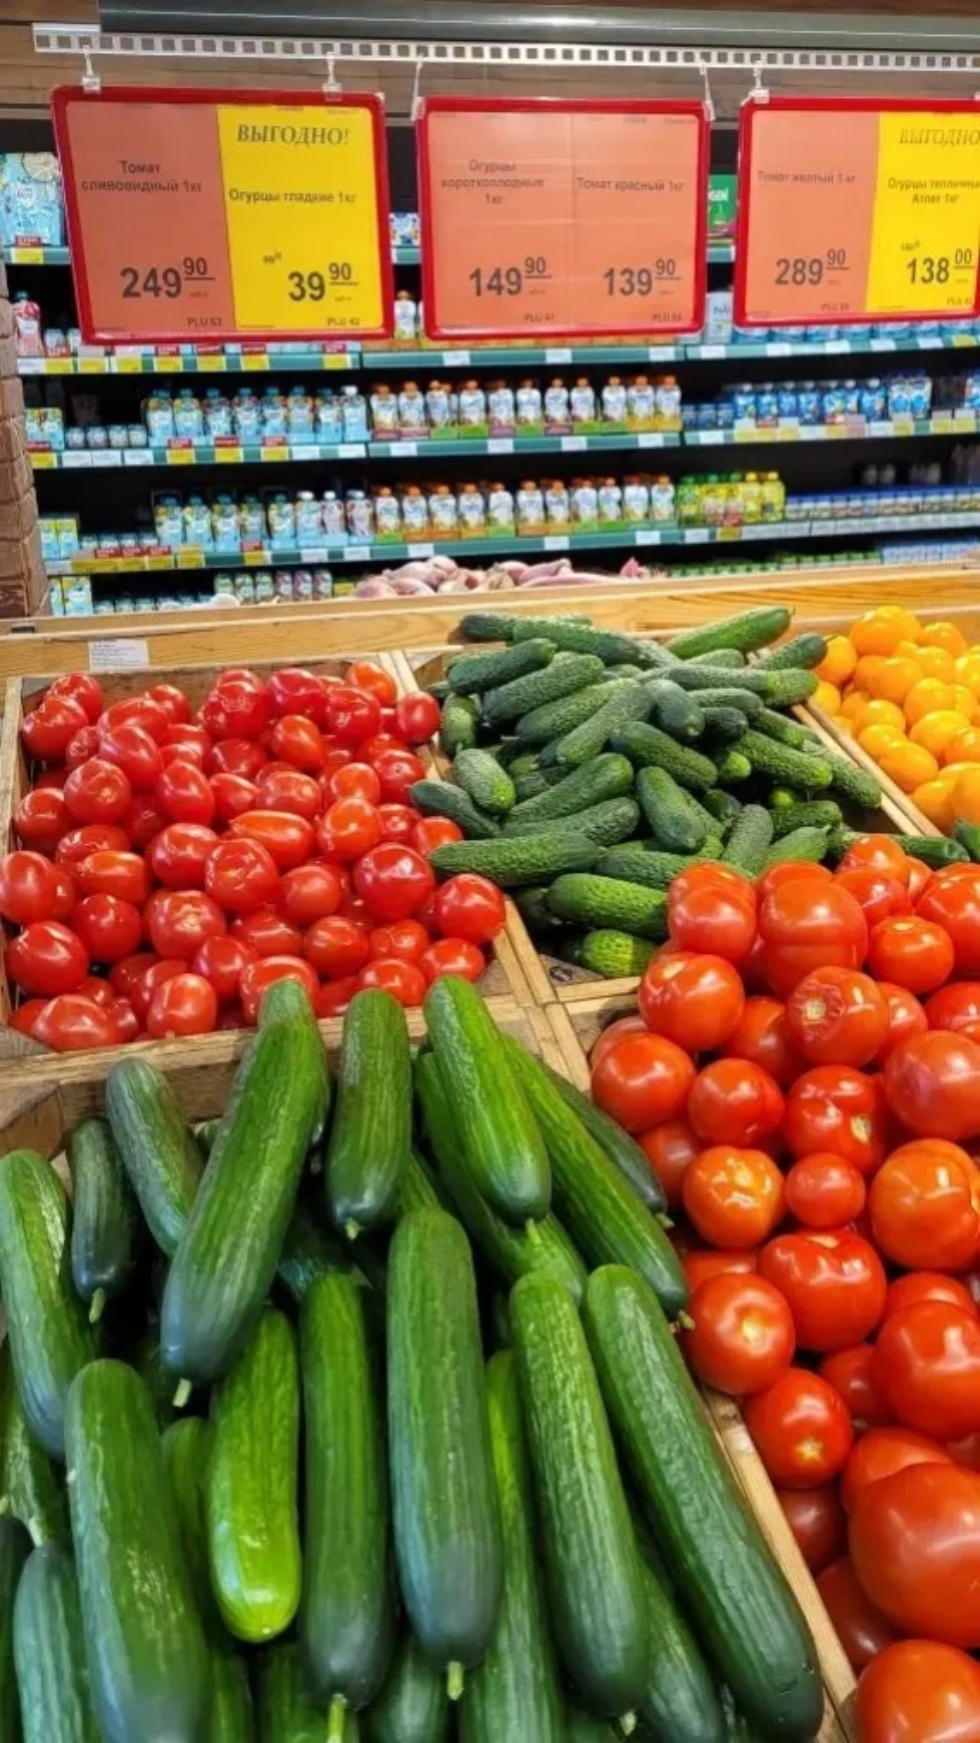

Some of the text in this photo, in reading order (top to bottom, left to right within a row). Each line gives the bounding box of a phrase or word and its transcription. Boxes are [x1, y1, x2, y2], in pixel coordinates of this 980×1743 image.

[236, 124, 350, 146] ВЫГОДНО!
[119, 160, 161, 174] Томат
[469, 159, 516, 173] Огурцы
[81, 180, 203, 194] сливовидный 1кг
[577, 177, 612, 190] Томат
[614, 180, 665, 193] красный
[888, 177, 928, 191] Огурцы
[229, 188, 280, 204] Огурцы
[284, 191, 334, 204] гладкие
[774, 249, 847, 285] 289 90
[907, 248, 972, 284] 138 00
[120, 257, 208, 298] 249 90
[288, 262, 352, 301] 39 90
[469, 256, 546, 297] 149 90
[603, 259, 676, 296] 139 90
[187, 317, 208, 327] PLU
[327, 317, 346, 326] PLU
